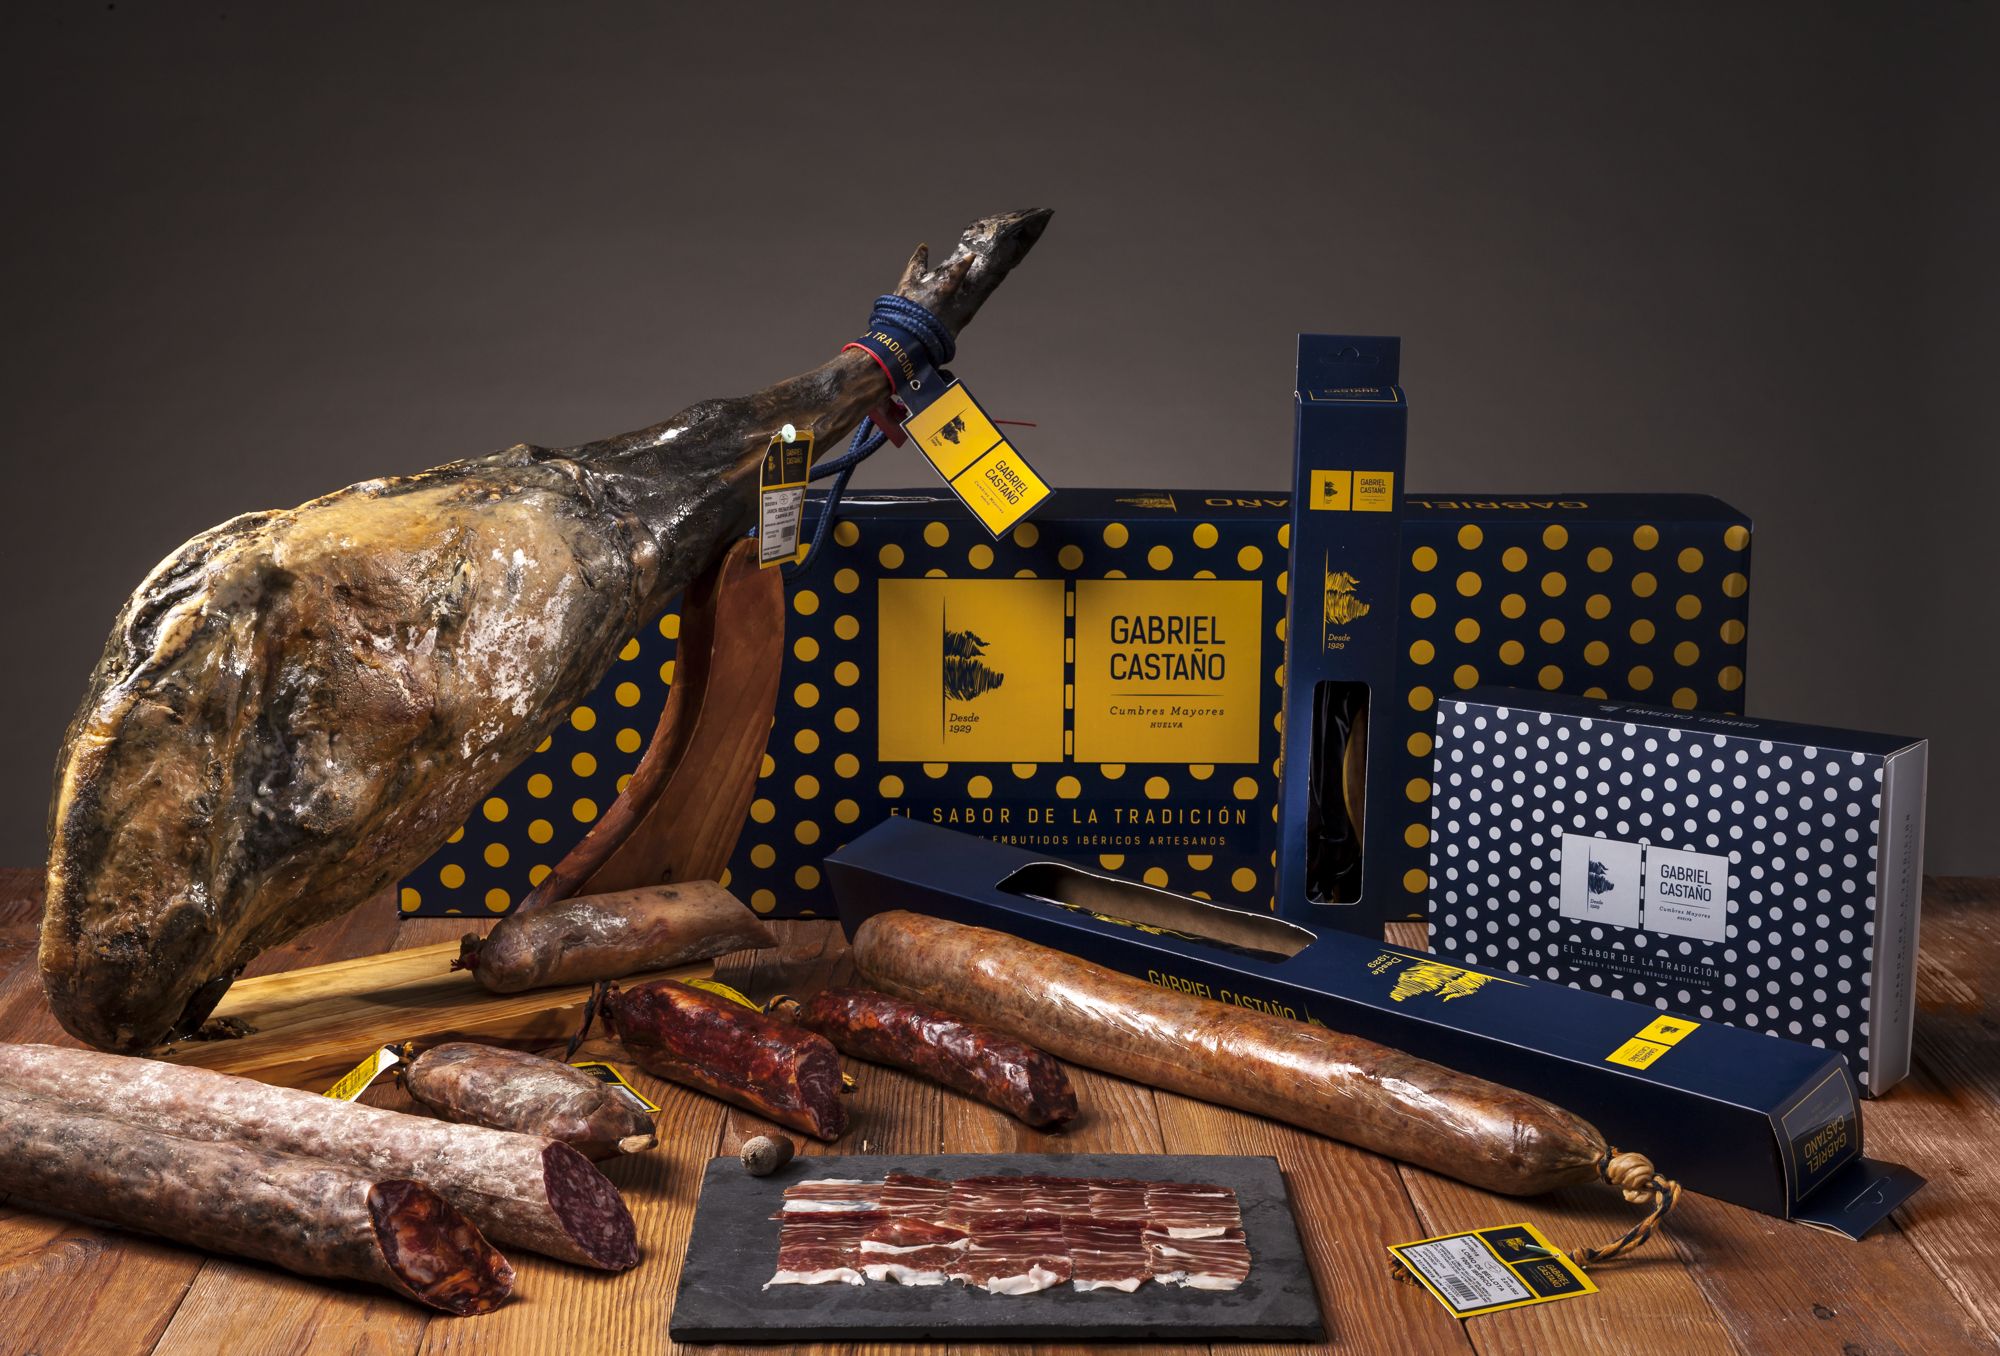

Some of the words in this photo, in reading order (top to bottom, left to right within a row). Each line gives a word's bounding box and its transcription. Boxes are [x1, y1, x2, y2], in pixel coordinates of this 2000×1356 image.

[984, 468, 1020, 505] CASTAÑO
[995, 459, 1028, 497] GABRIEL
[1360, 478, 1386, 487] GABRIEL
[1110, 615, 1226, 645] GABRIEL
[1327, 633, 1352, 641] Desde
[1327, 642, 1345, 650] 1929
[1110, 648, 1226, 681] CASTAÑO
[949, 712, 980, 723] Desde
[1109, 706, 1165, 716] Cumbres
[1170, 706, 1225, 718] Mayores
[949, 724, 972, 734] 1929
[933, 807, 1010, 824] SABOR
[1028, 808, 1055, 824] DE
[1073, 808, 1098, 824] LA
[1114, 806, 1246, 825] TRADICIÓN
[992, 835, 1069, 845] EMBUTIDOS
[1077, 835, 1141, 846] IBÉRICOS
[1149, 836, 1226, 846] ARTESANOS
[1660, 864, 1712, 886] GABRIEL
[1659, 882, 1712, 902] CASTAÑO
[1367, 954, 1390, 968] 1929
[1371, 956, 1402, 975] Desde
[1563, 944, 1575, 954] EL
[1581, 947, 1616, 960] SABOR
[1622, 954, 1635, 964] DE
[1642, 957, 1654, 967] LA
[1660, 960, 1720, 979] TRADICIÓN
[1804, 1114, 1845, 1159] CASTAÑO
[1806, 1132, 1847, 1174] GABRIEL
